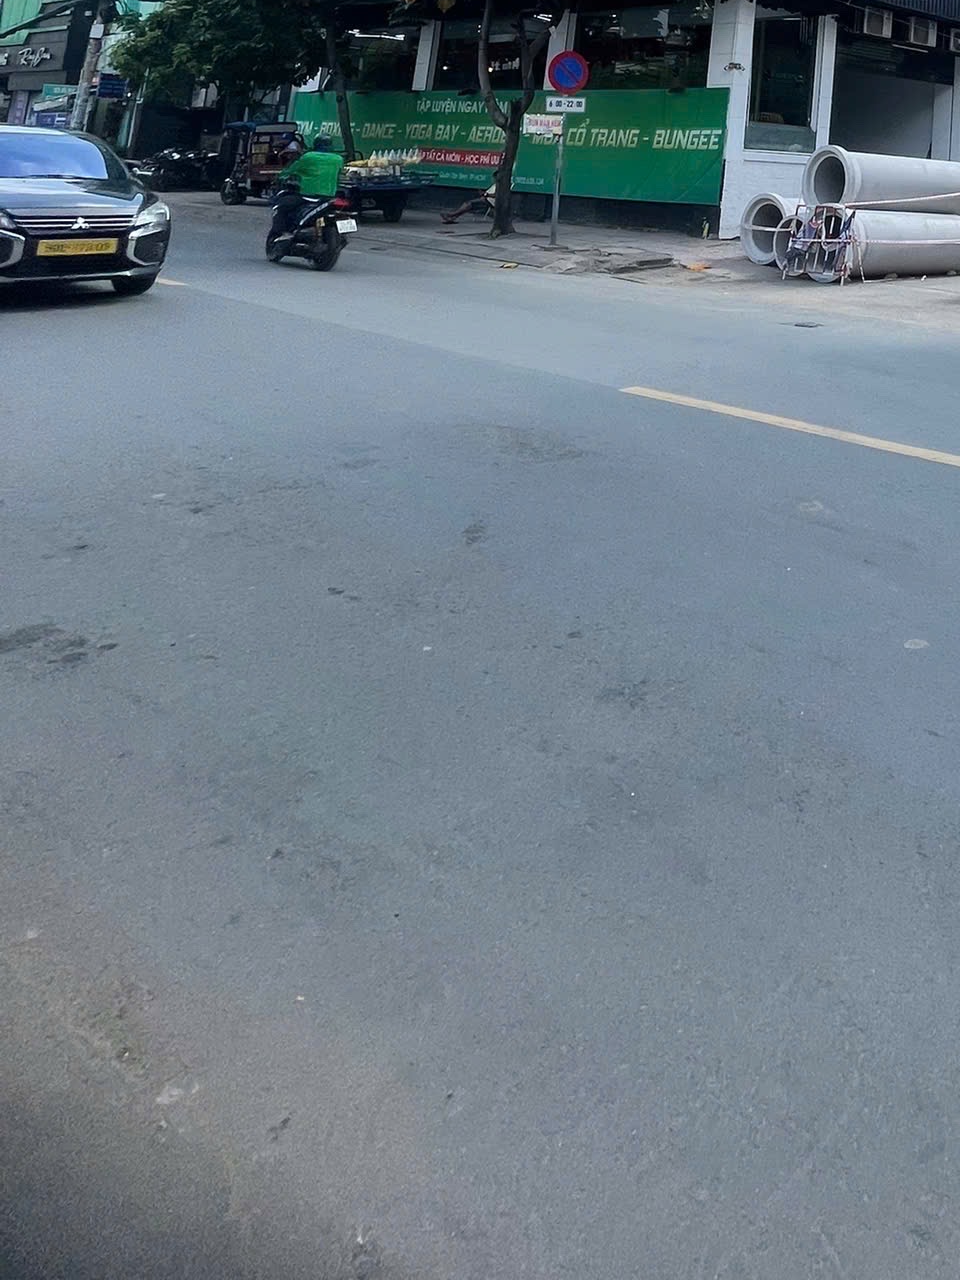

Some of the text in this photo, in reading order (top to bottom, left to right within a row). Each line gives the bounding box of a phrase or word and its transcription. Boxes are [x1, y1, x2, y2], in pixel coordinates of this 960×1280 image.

[417, 99, 431, 114] TẬP
[432, 98, 457, 115] LUYỆN
[457, 101, 484, 113] NGAY
[362, 123, 396, 138] DANCE
[405, 124, 433, 139] YOGA
[435, 124, 460, 141] BAY
[566, 118, 588, 145] CỔ
[590, 127, 641, 148] TRANG
[652, 129, 723, 150] BUNGEE
